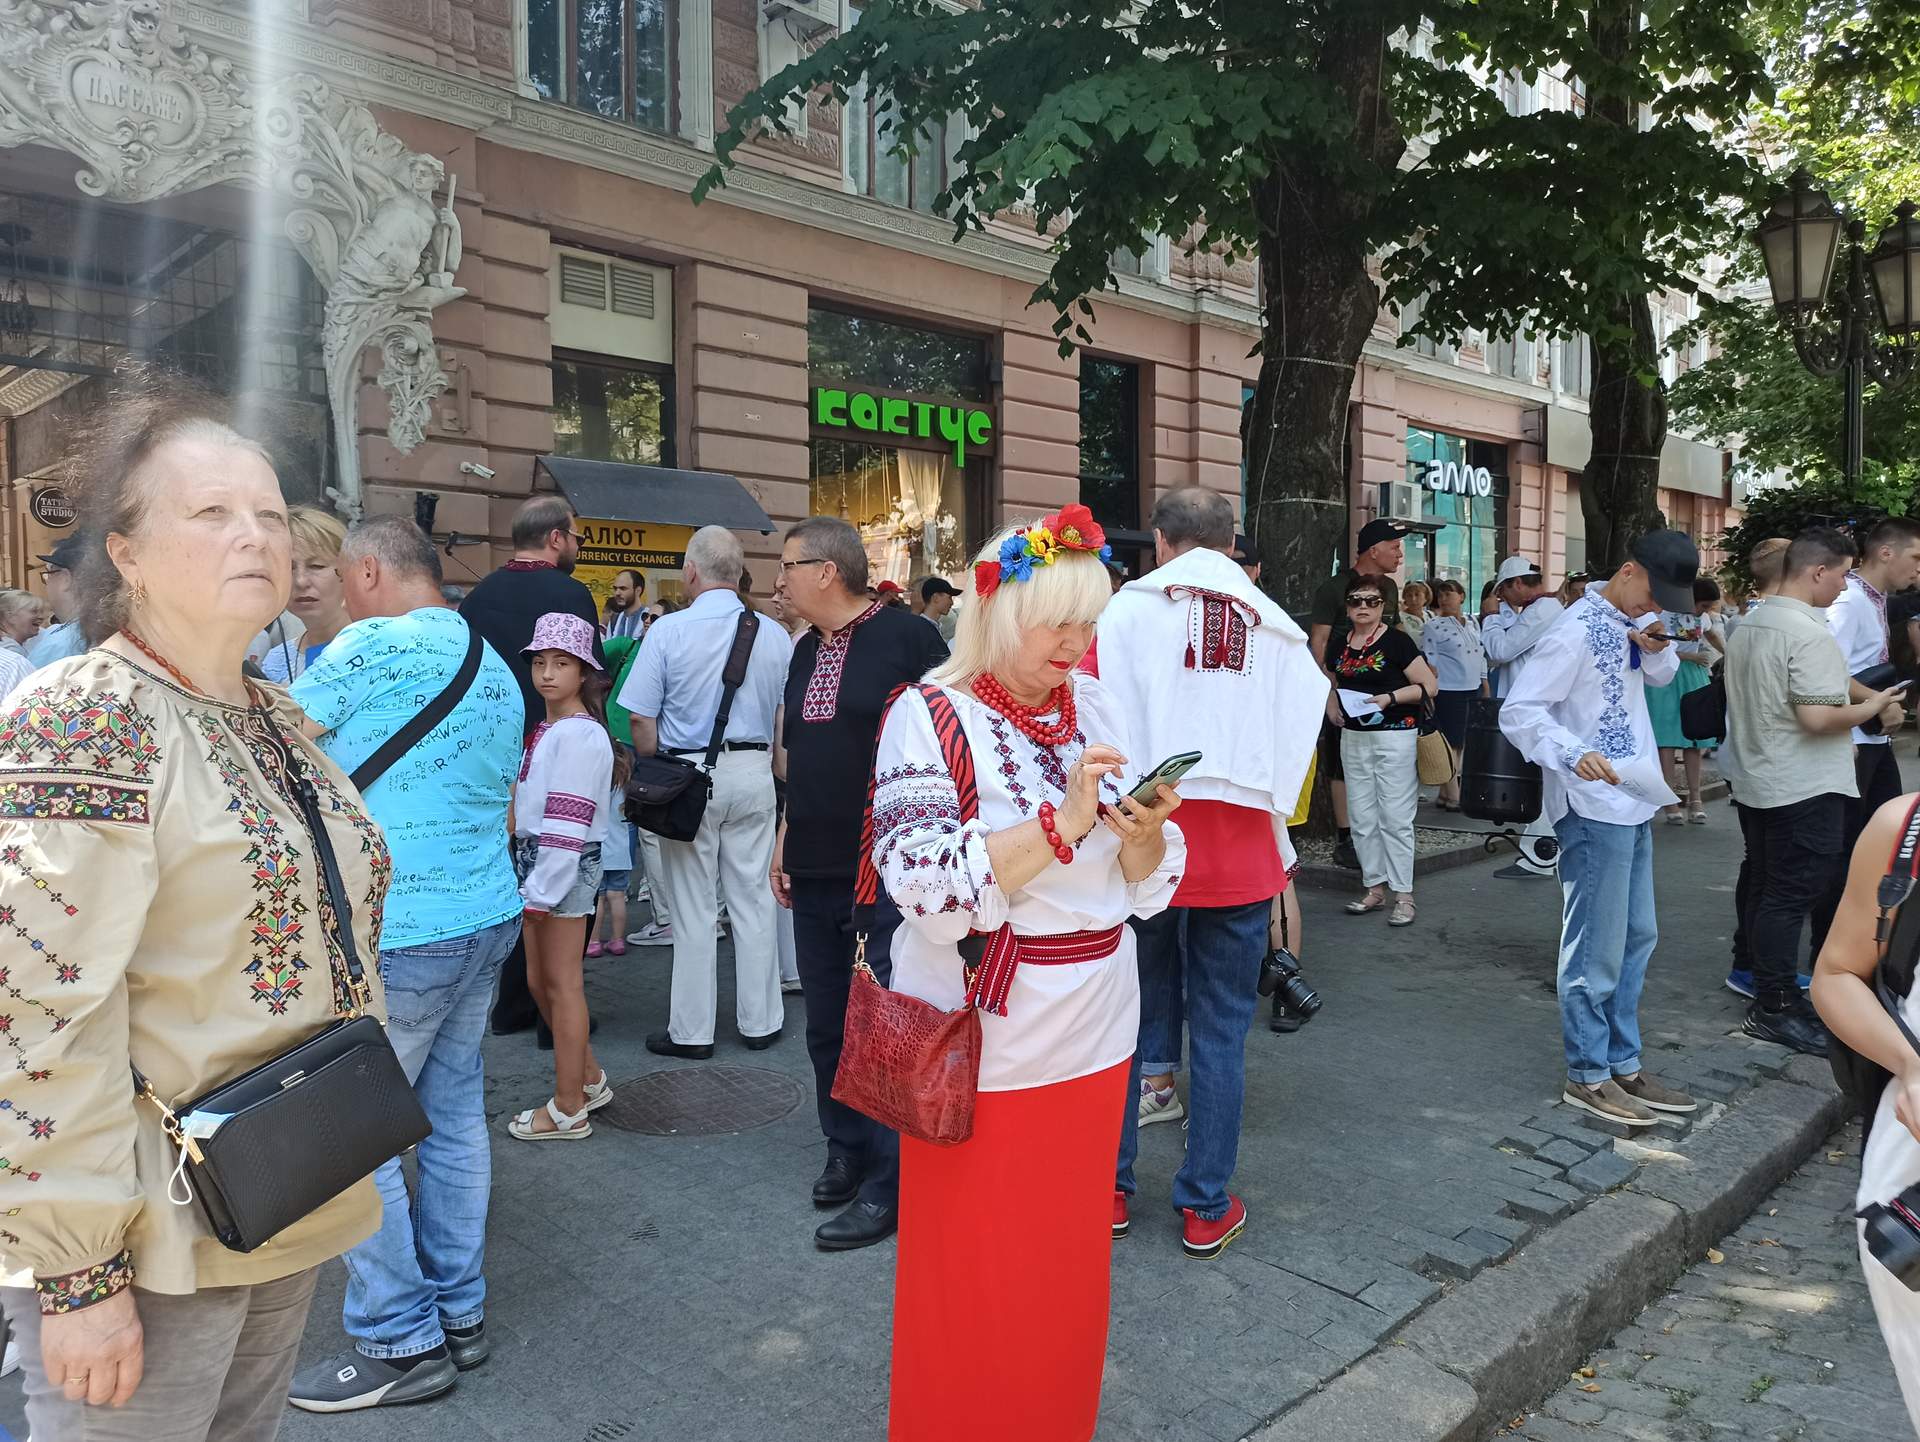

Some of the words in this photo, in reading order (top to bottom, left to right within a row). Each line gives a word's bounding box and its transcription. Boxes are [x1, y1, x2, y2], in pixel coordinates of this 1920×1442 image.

[87, 77, 182, 124] ПАССАЖЪ
[40, 508, 73, 518] STUDIO
[582, 526, 647, 547] АЛЮТ
[575, 550, 621, 562] URRENCY
[623, 553, 676, 565] EXCHANGE
[1898, 804, 1920, 859] anon
